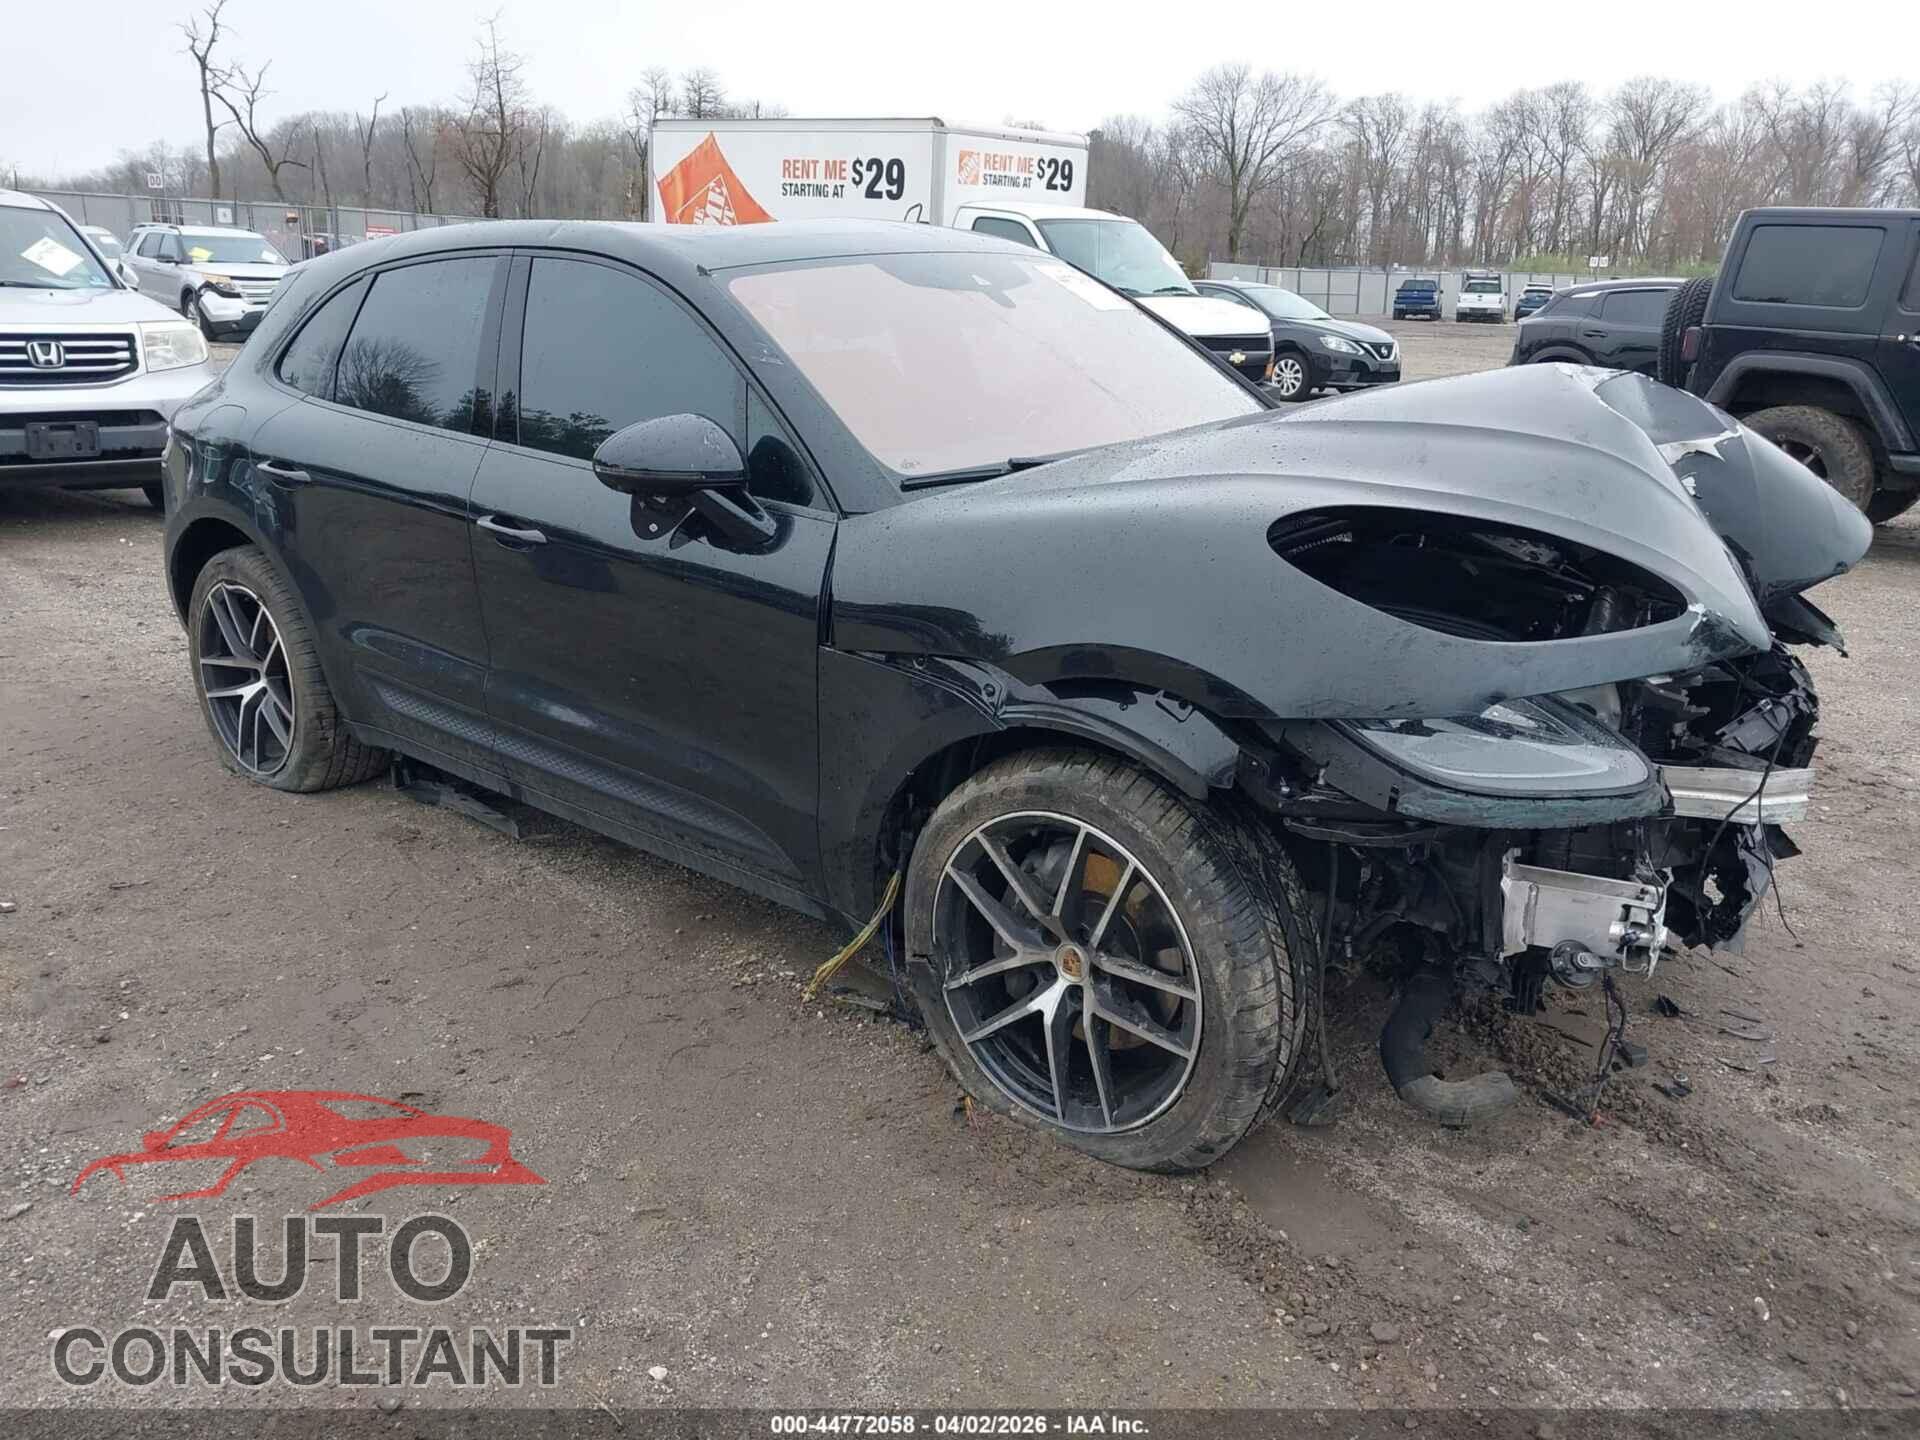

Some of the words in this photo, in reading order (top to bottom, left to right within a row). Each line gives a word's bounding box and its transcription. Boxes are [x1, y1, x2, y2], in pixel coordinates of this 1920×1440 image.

[782, 159, 818, 180] RENT
[824, 160, 847, 181] ME
[983, 152, 1014, 172] RENT
[1016, 156, 1034, 174] ME
[851, 157, 905, 201] $29
[982, 173, 1020, 188] STARTING
[1022, 177, 1032, 189] AT
[1037, 157, 1074, 192] $29
[782, 182, 829, 198] STARTING
[832, 184, 845, 199] AT
